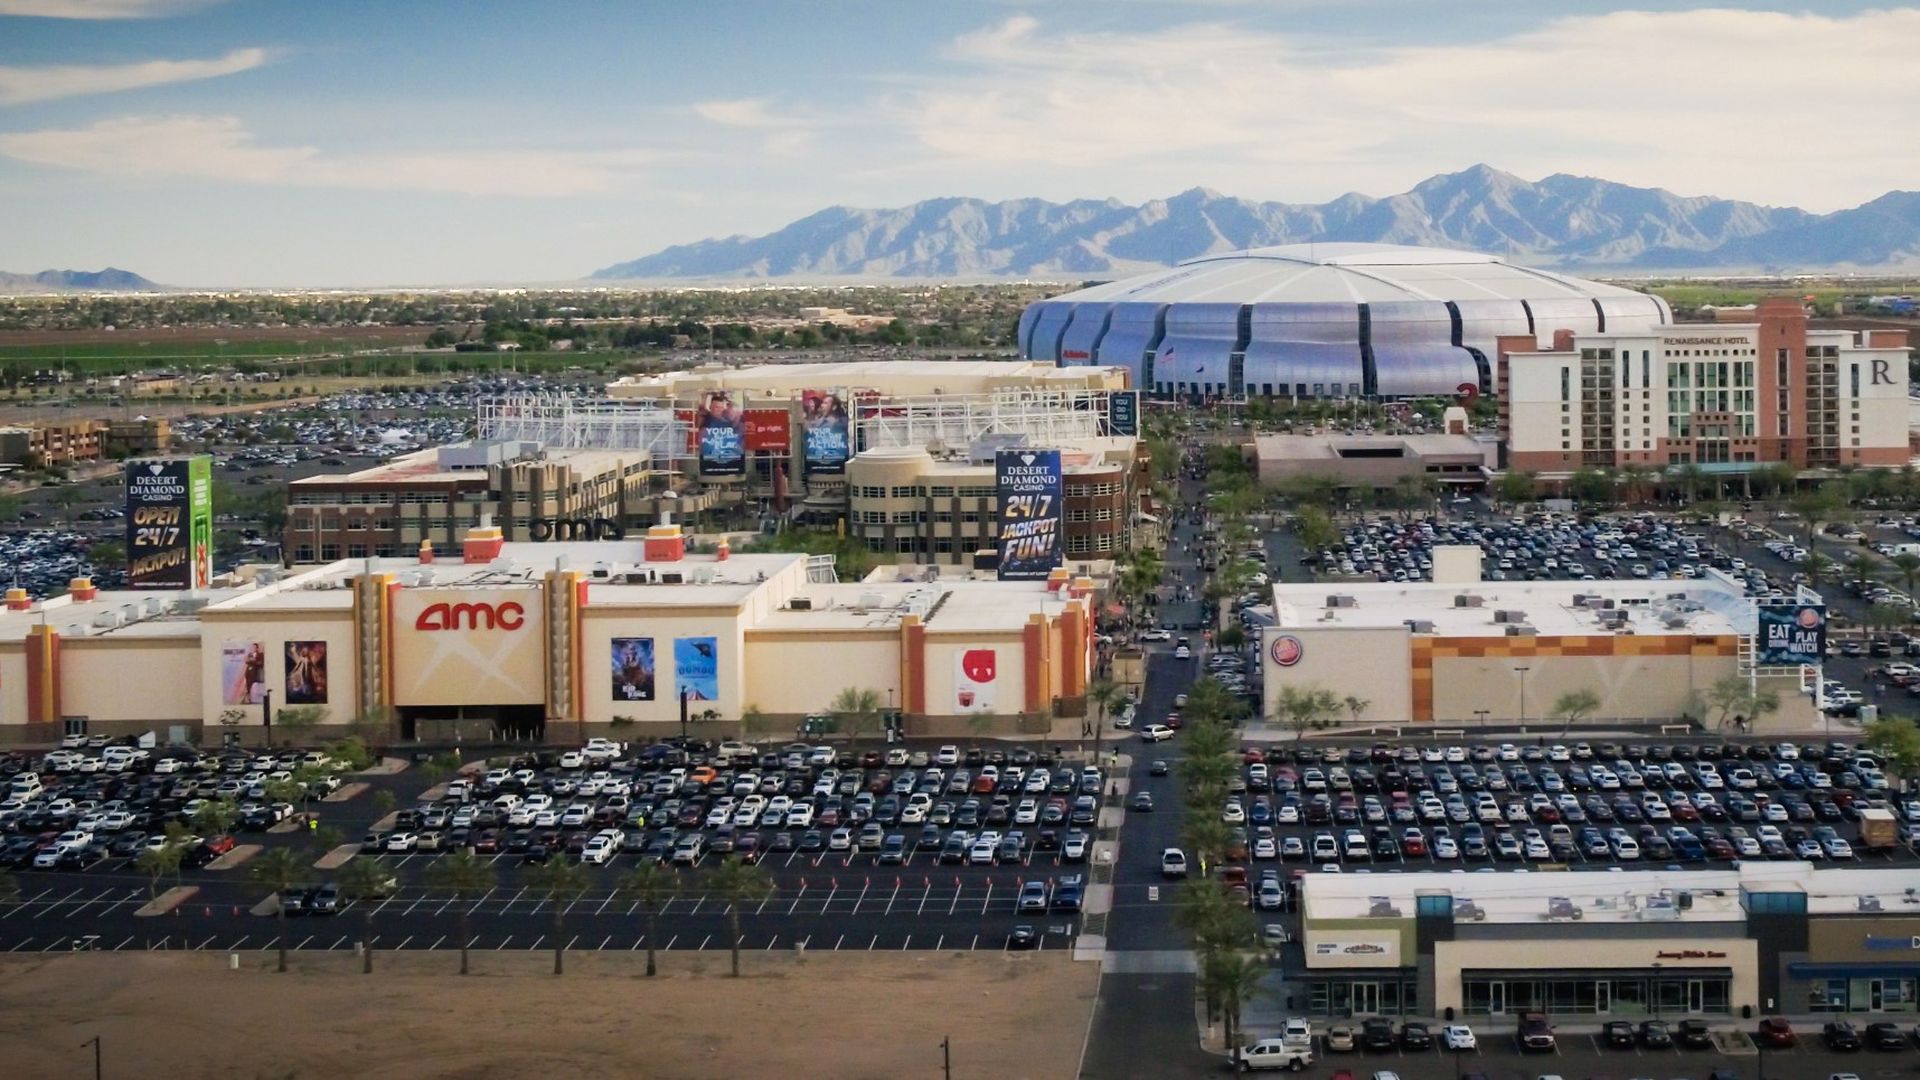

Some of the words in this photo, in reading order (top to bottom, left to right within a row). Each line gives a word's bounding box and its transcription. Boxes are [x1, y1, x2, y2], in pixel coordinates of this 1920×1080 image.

[1871, 360, 1897, 385] R
[706, 427, 734, 436] YOUR
[1008, 467, 1050, 475] DESERT
[136, 477, 178, 485] DESERT
[1001, 476, 1056, 484] DIAMOND
[130, 486, 185, 494] DIAMOND
[1005, 494, 1052, 518] 24/7
[134, 506, 181, 525] OPEN
[1001, 518, 1058, 539] JACKPOT
[135, 527, 180, 547] 24/7
[1003, 534, 1055, 563] FUN!
[131, 548, 185, 577] JACKPOT!
[1769, 624, 1790, 639] EAT
[1795, 632, 1818, 642] PLAY
[1790, 643, 1818, 653] WATCH
